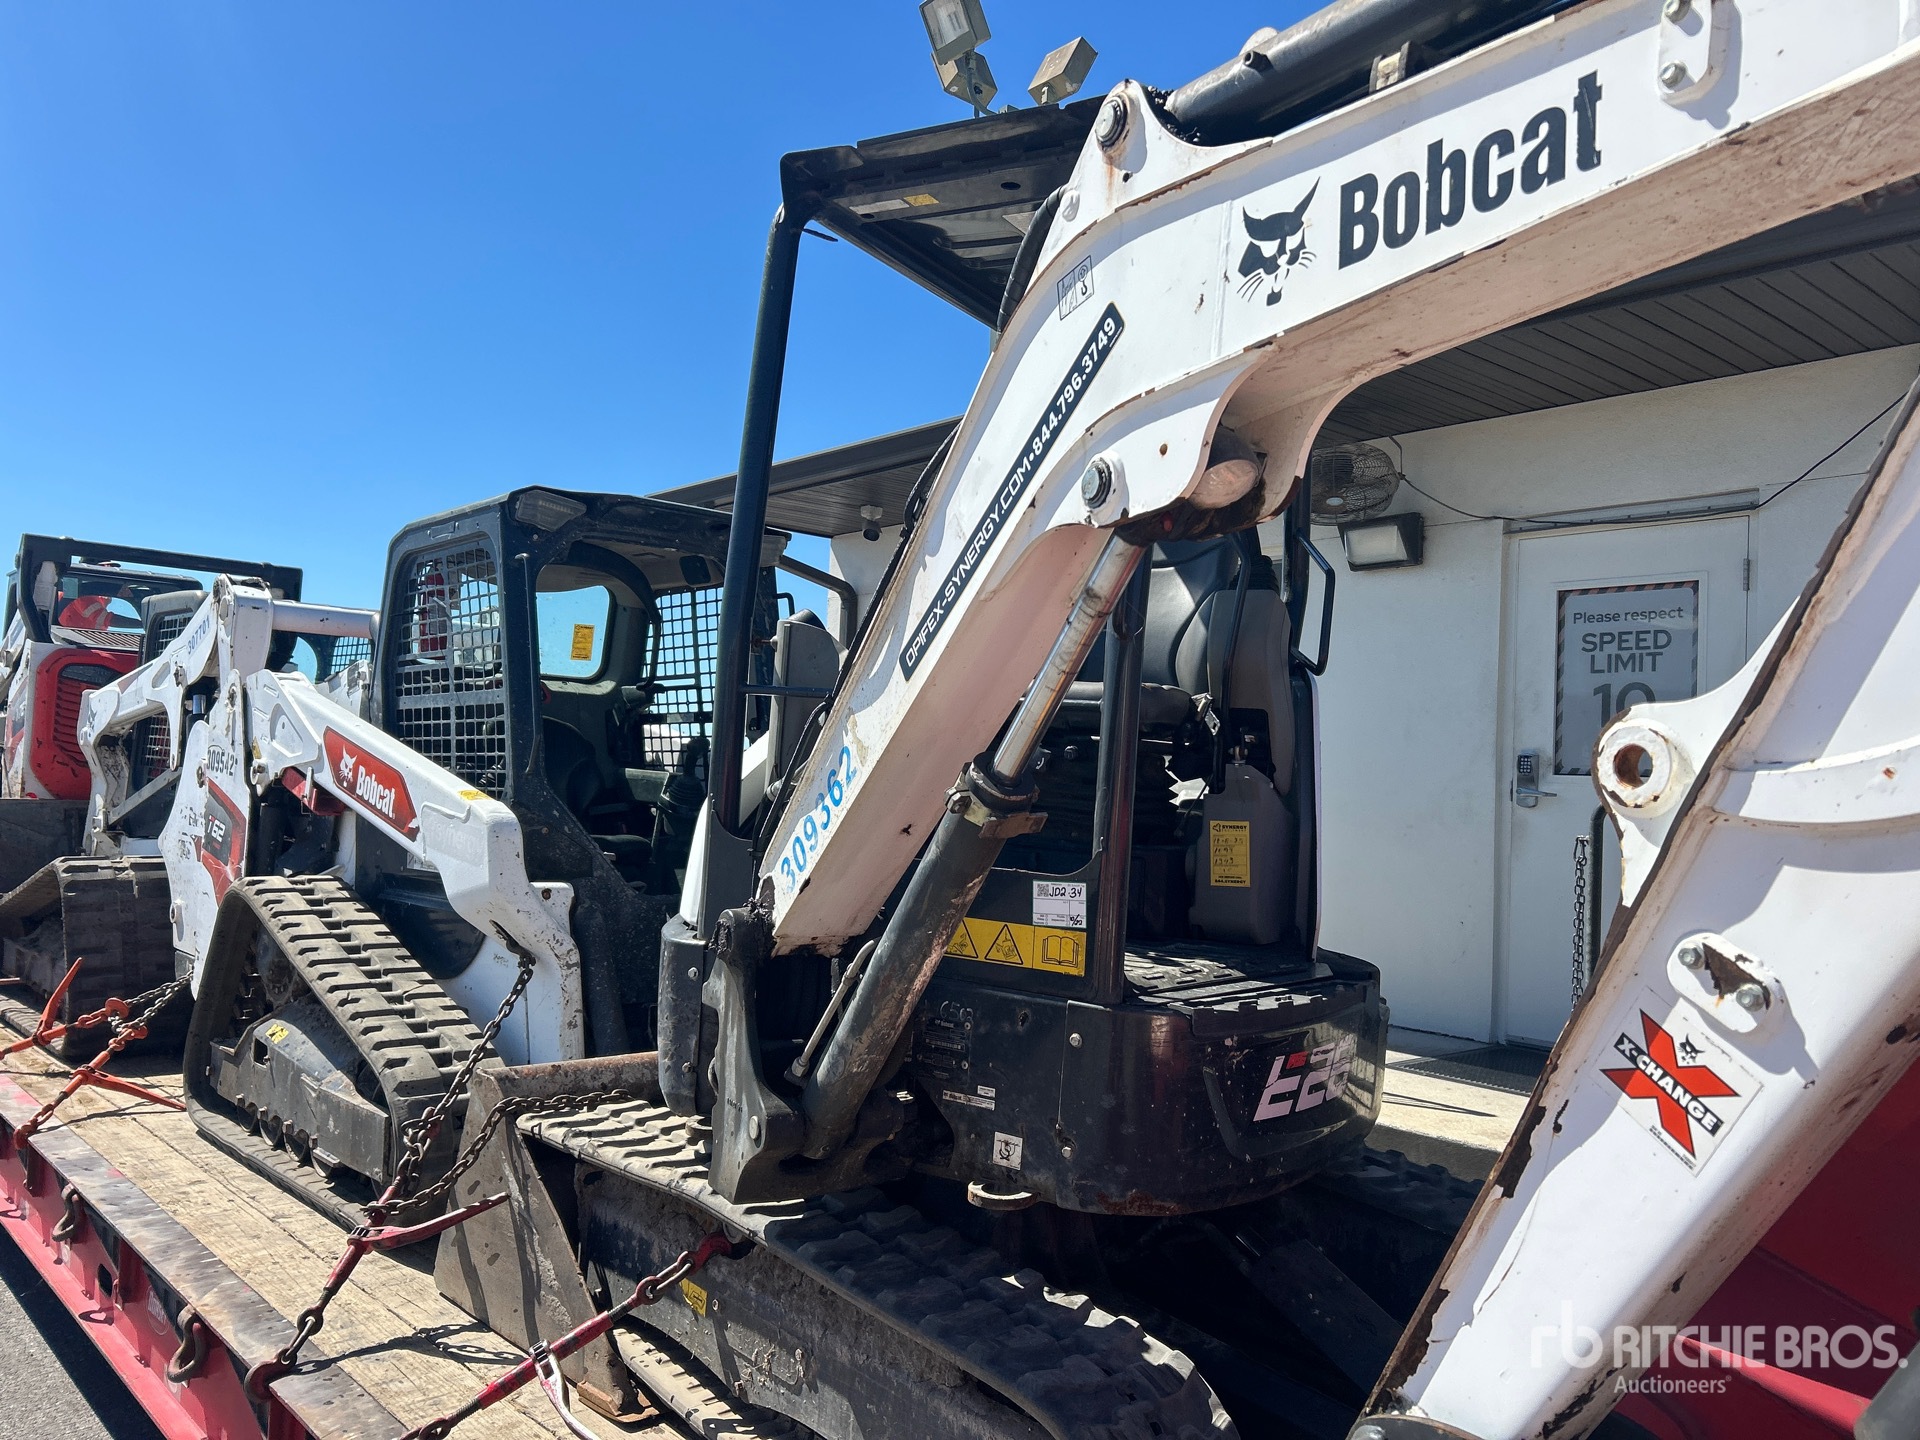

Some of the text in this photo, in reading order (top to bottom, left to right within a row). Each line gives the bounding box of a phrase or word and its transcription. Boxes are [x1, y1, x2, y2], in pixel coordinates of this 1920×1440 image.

[1338, 69, 1603, 270] Bobcat
[1573, 606, 1684, 624] Please respect
[1581, 629, 1672, 653] SPEED
[1590, 652, 1663, 674] LIMIT
[356, 764, 396, 820] Bobcat
[781, 745, 858, 894] 309362
[1616, 1036, 1719, 1131] X-CHANGE
